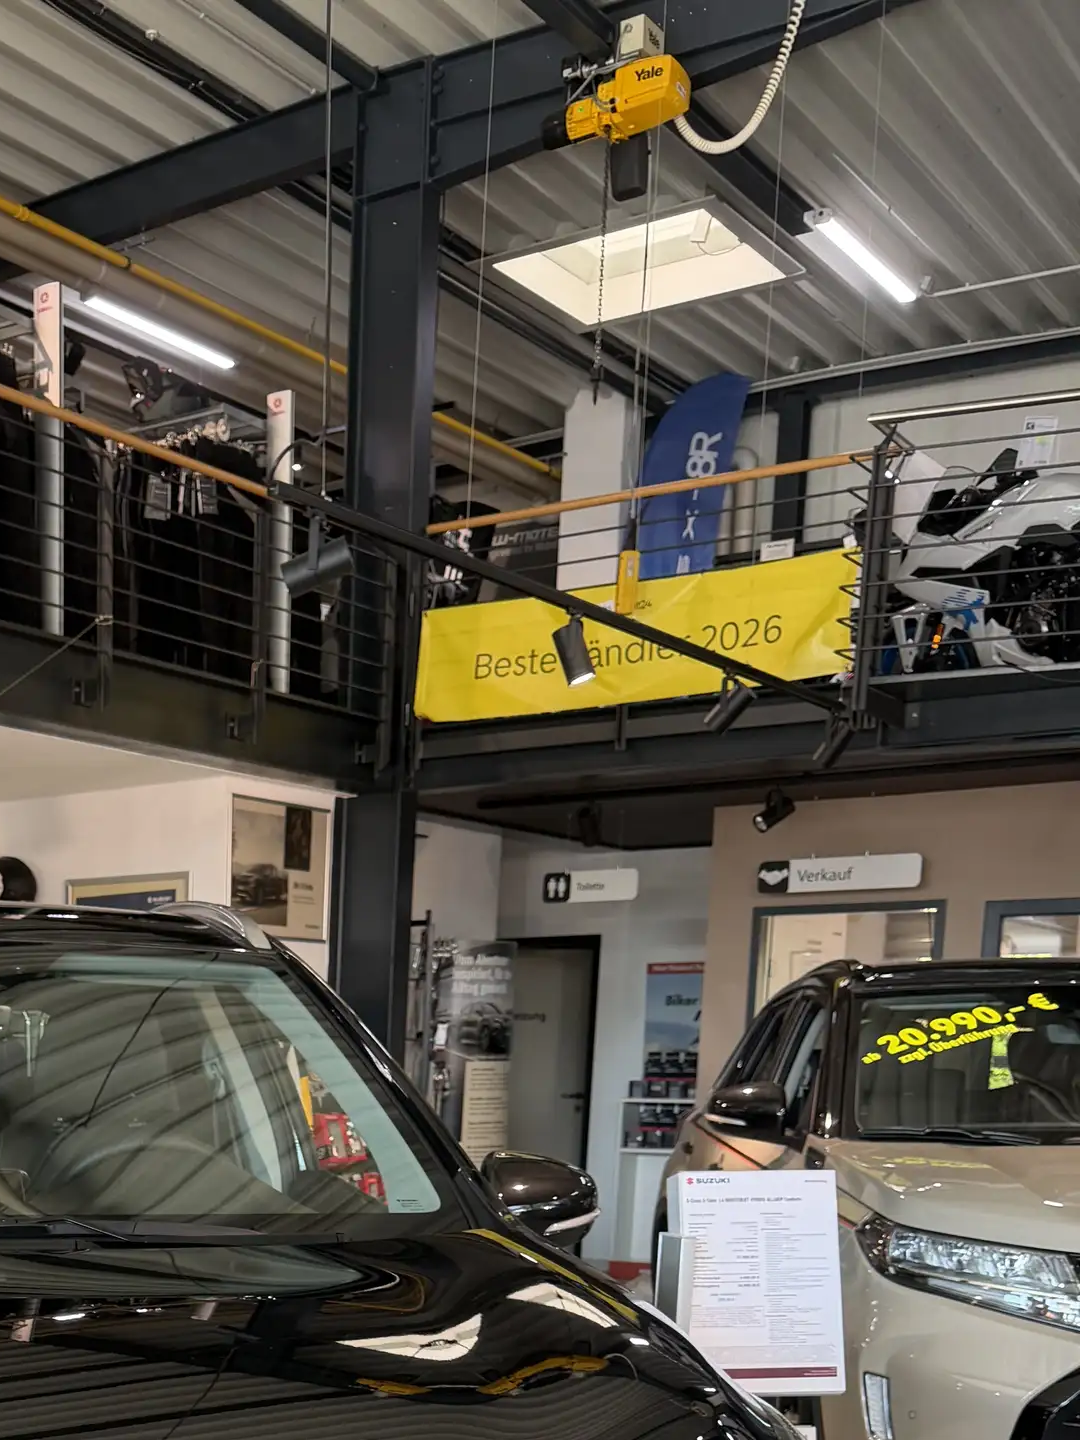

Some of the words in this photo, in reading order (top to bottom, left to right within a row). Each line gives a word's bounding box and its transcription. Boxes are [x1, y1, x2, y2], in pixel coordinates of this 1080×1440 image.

[634, 65, 664, 82] Yale
[701, 614, 782, 652] 2026
[797, 867, 855, 883] Verkauf
[861, 1052, 882, 1065] ab
[877, 1006, 1026, 1055] 20.990,-
[1027, 992, 1059, 1011] €
[898, 1047, 933, 1064] zzgl.
[930, 1024, 1018, 1053] Überführung
[696, 1177, 730, 1185] SUZUKI
